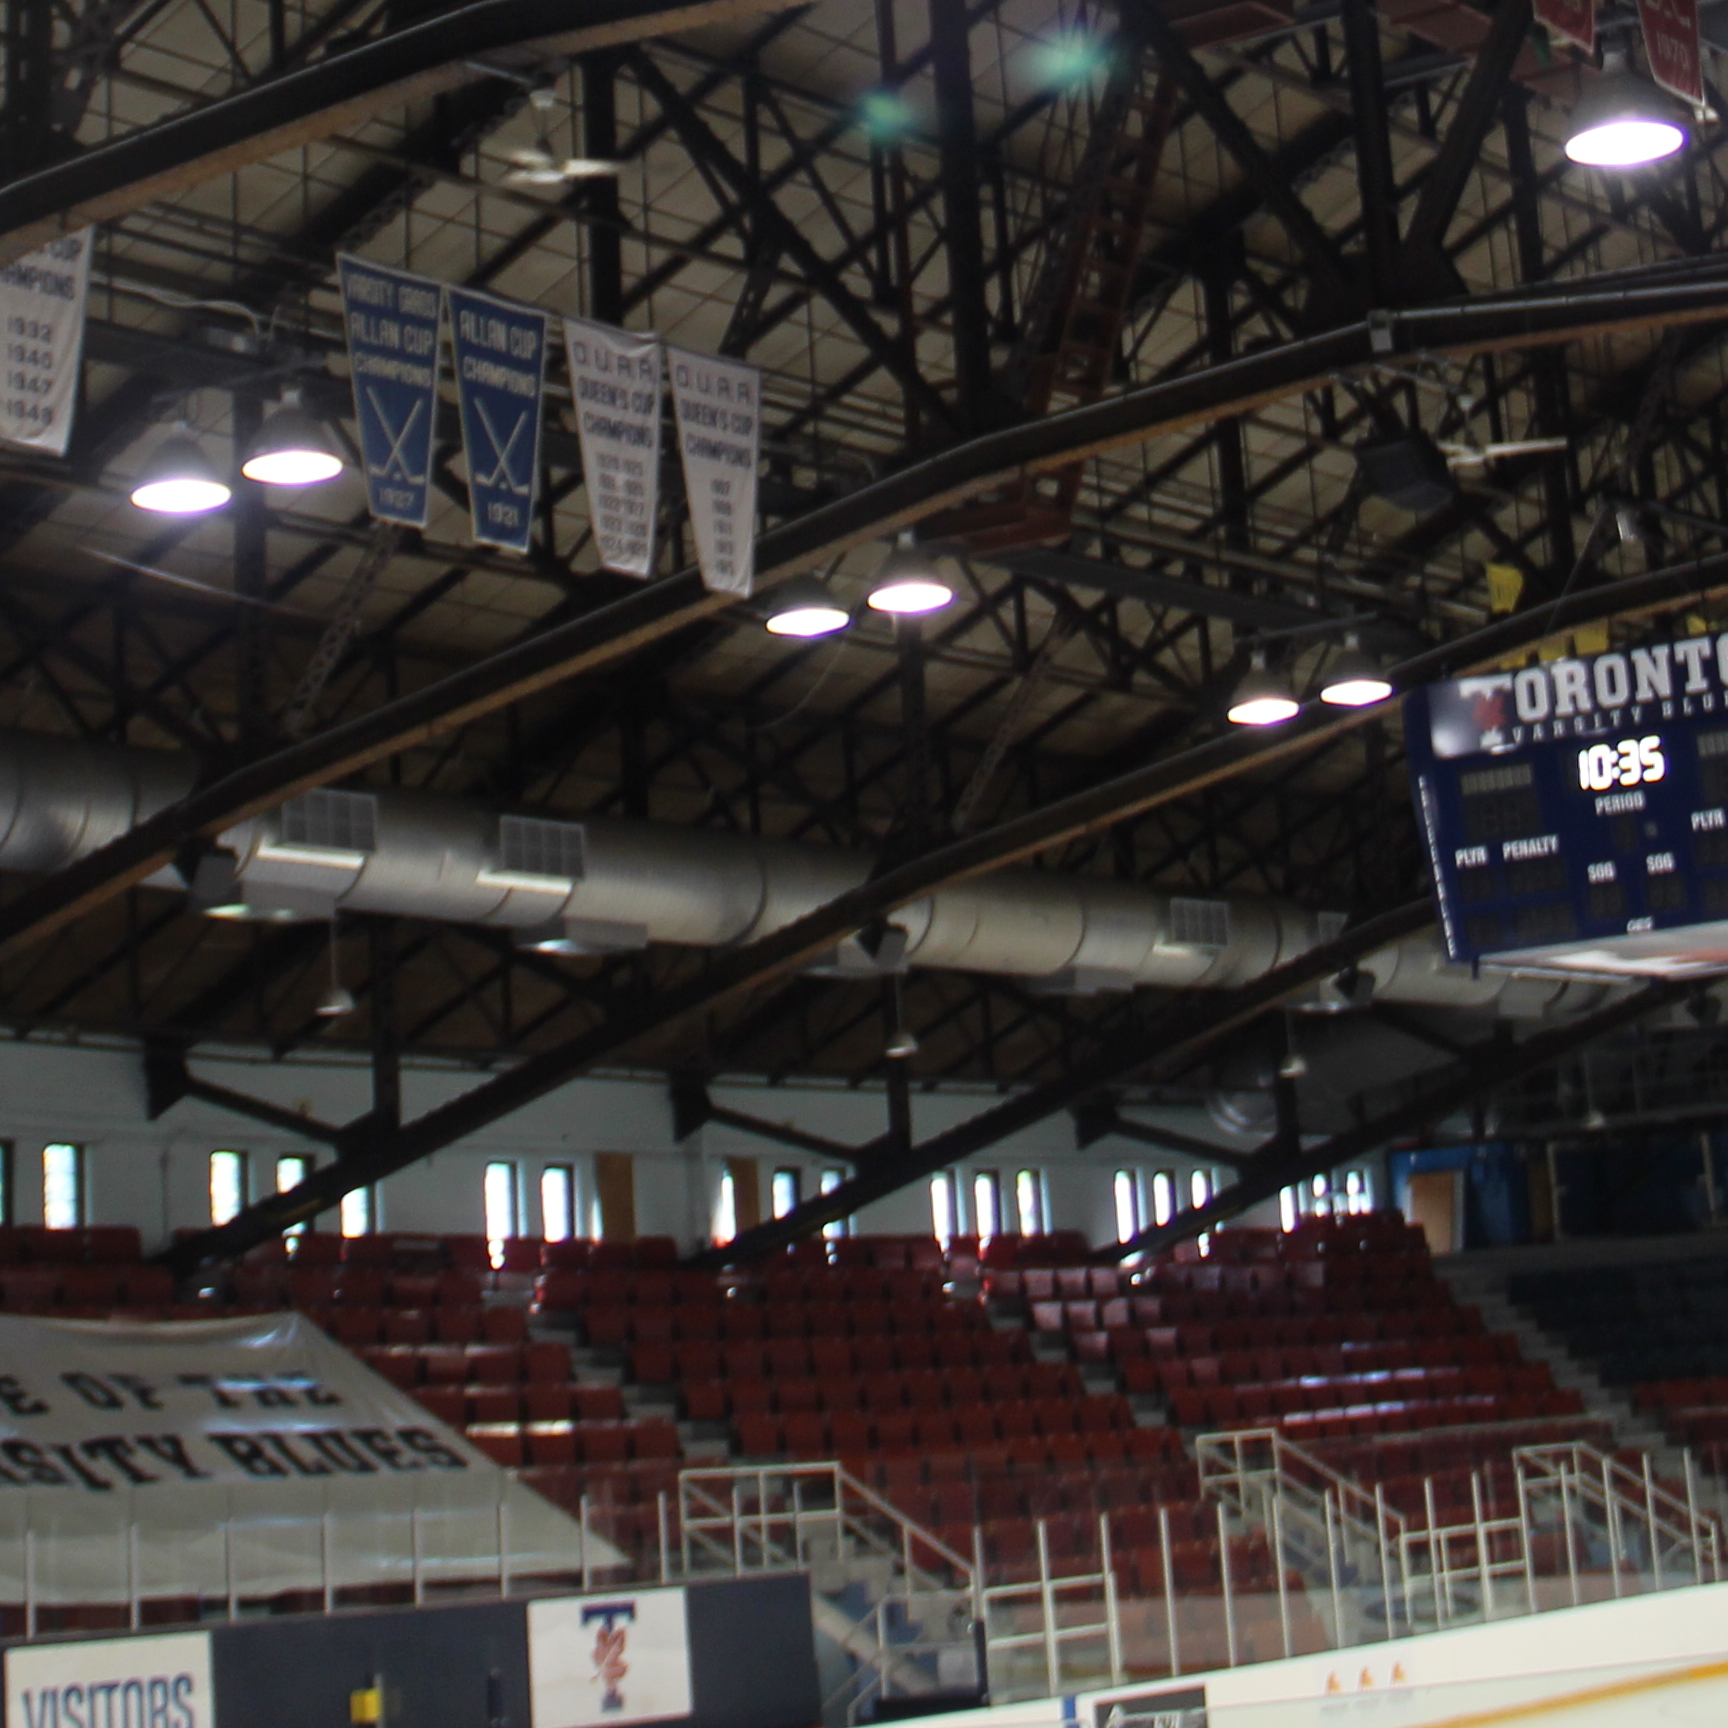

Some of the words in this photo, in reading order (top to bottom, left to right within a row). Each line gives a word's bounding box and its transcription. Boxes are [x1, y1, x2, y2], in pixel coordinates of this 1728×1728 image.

[350, 311, 400, 350] ALLAN
[403, 324, 434, 355] CUP
[459, 309, 507, 352] ALLAN
[509, 326, 537, 359] CUP
[1512, 705, 1643, 746] VARSITY
[1577, 734, 1669, 791] 10:35
[1594, 790, 1647, 817] PERIOD
[1691, 808, 1727, 832] PLYR
[1455, 846, 1489, 870] PLYR
[1502, 834, 1559, 862] PENALTY
[60, 1371, 165, 1410] OF
[176, 1369, 341, 1408] THE
[208, 1429, 469, 1478] BLUES
[20, 1671, 194, 1728] VISITORS
